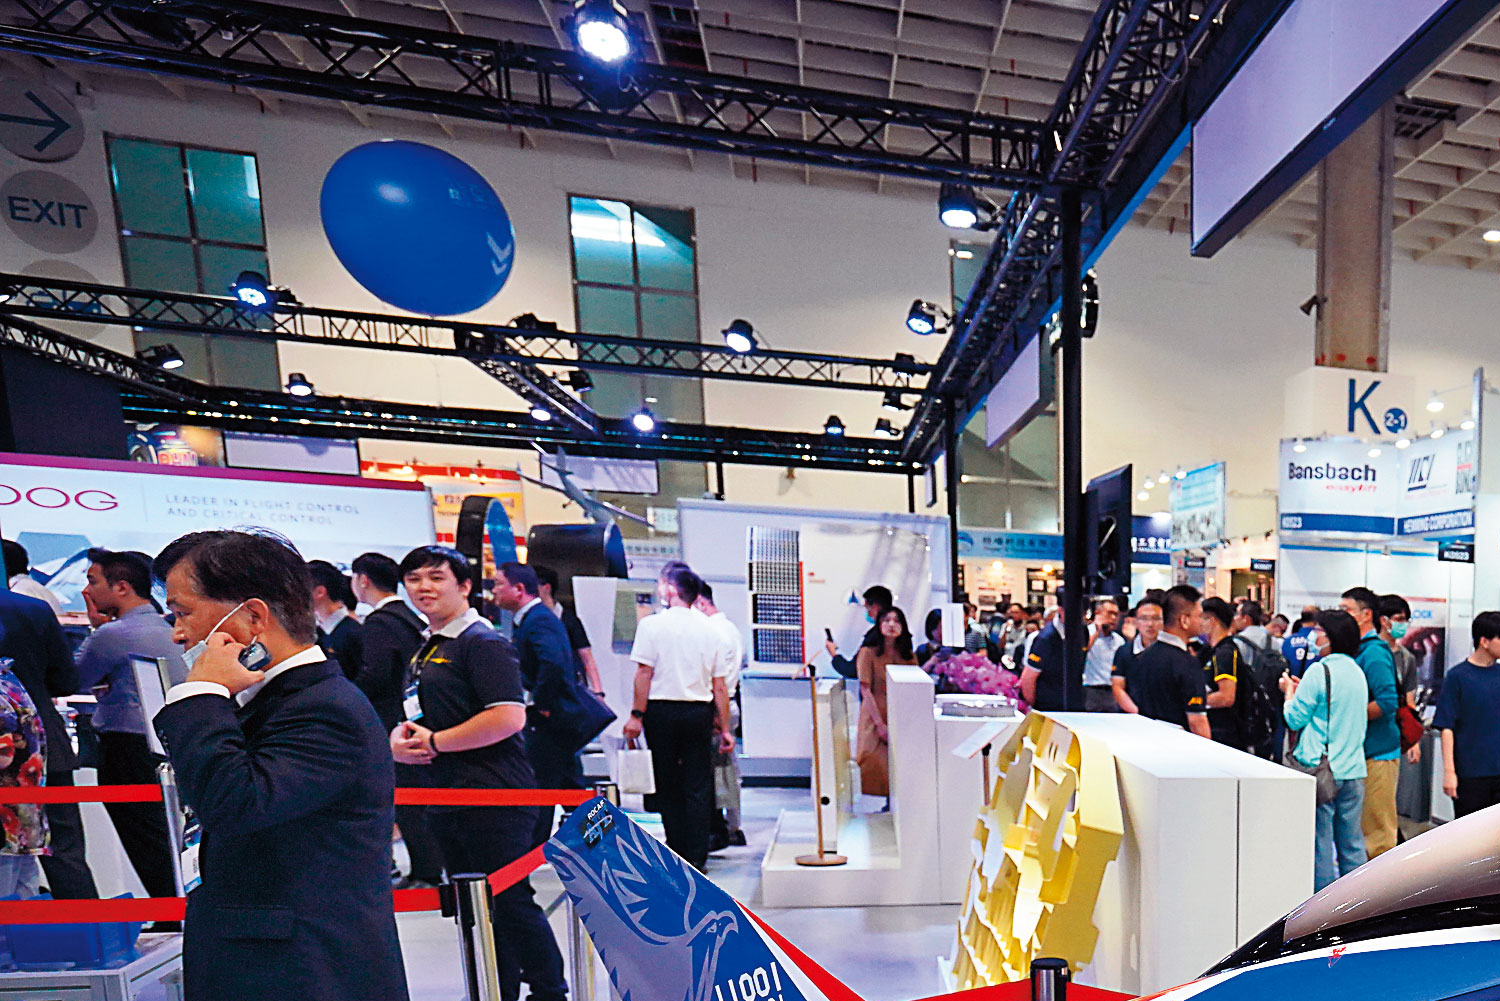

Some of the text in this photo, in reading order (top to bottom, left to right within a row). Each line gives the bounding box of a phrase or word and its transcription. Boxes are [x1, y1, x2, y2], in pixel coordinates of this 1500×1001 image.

[7, 196, 89, 230] EXIT
[1347, 377, 1382, 435] K
[1288, 462, 1377, 482] Bansbach
[587, 799, 605, 821] ROCAF
